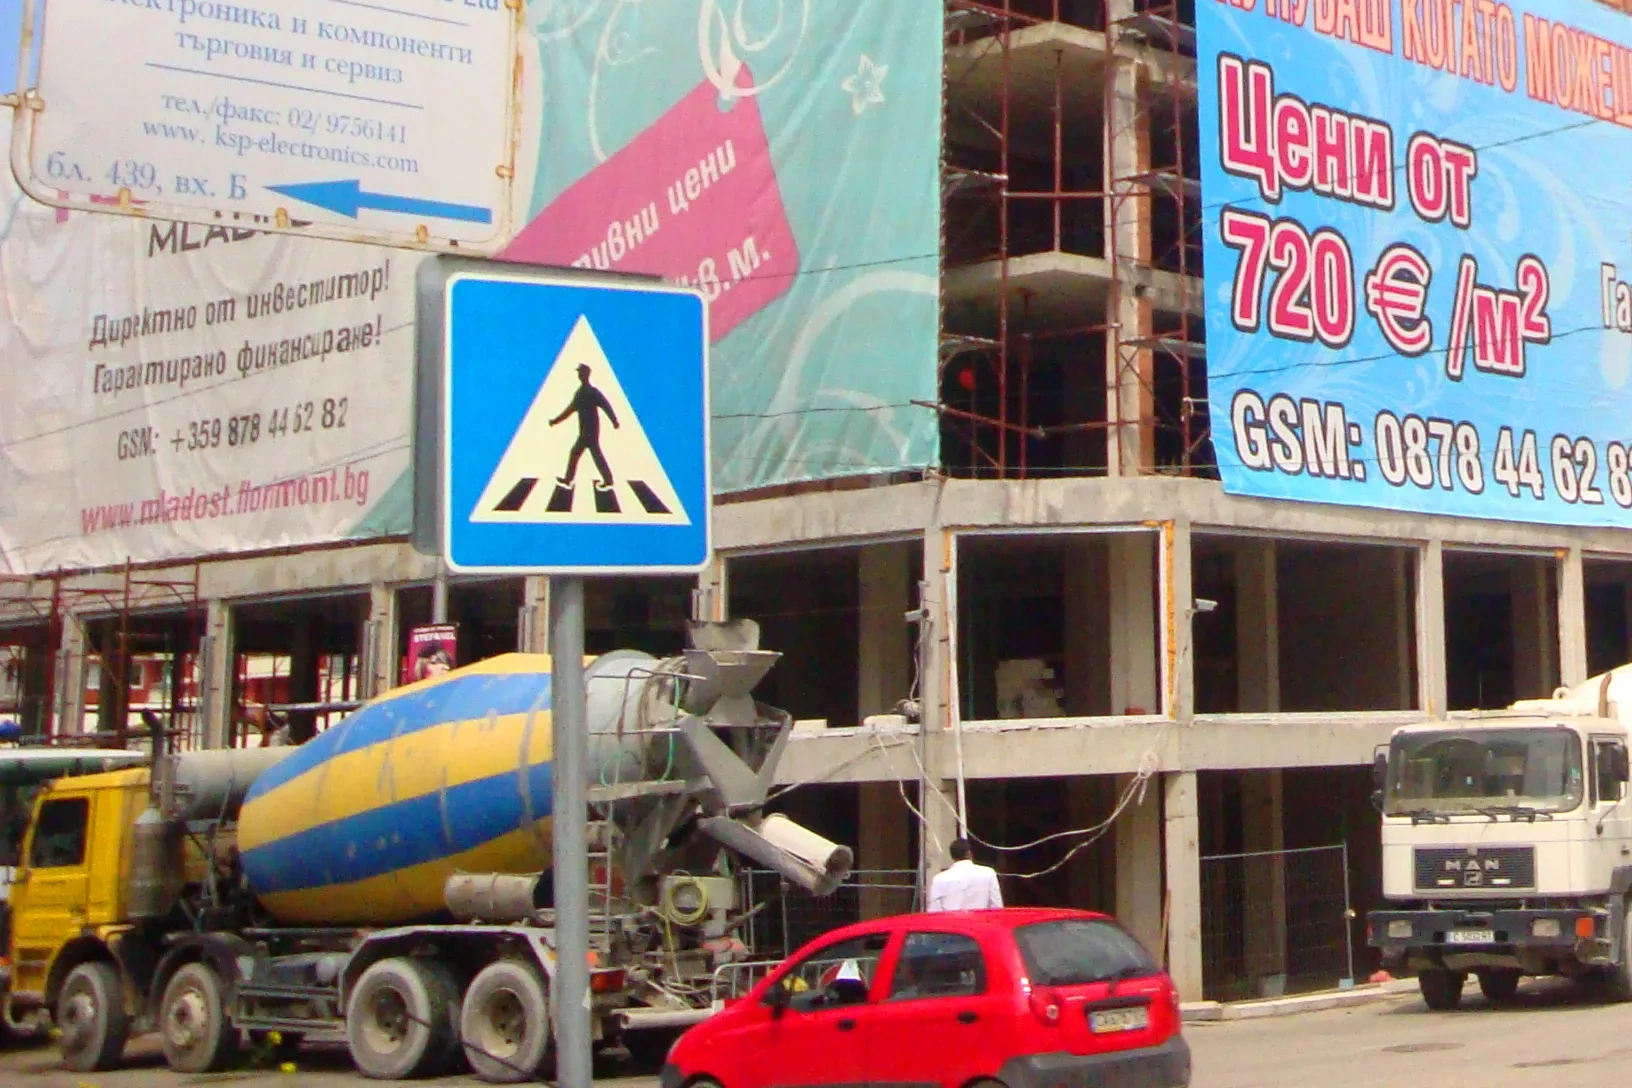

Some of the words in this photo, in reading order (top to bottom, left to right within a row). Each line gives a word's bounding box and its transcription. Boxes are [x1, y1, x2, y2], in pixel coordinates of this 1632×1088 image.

[174, 31, 292, 65] търговия
[301, 53, 316, 70] и
[325, 57, 403, 84] сервиз
[292, 17, 307, 35] и
[318, 21, 473, 64] компоненти
[215, 124, 419, 173] ksp-electronics.com
[326, 114, 406, 145] 9756141
[1217, 51, 1395, 211] Цени
[1406, 130, 1477, 230] от
[46, 151, 92, 182] бл.
[175, 175, 215, 197] вх.
[228, 173, 247, 200] Б
[667, 140, 737, 215] цени
[89, 305, 197, 352] Директно
[205, 297, 236, 326] от
[246, 259, 390, 320] инвеститор!
[1221, 204, 1353, 349] 720
[1363, 242, 1431, 356] €
[237, 314, 382, 379] финансиране!
[170, 418, 221, 453] +359
[228, 413, 261, 447] 878
[268, 407, 289, 439] 44
[321, 397, 348, 429] 82
[1230, 387, 1366, 481] GSM:
[1373, 409, 1485, 495] 0878
[1493, 425, 1545, 501] 44
[1551, 433, 1604, 504] 62
[1445, 859, 1499, 871] MAN
